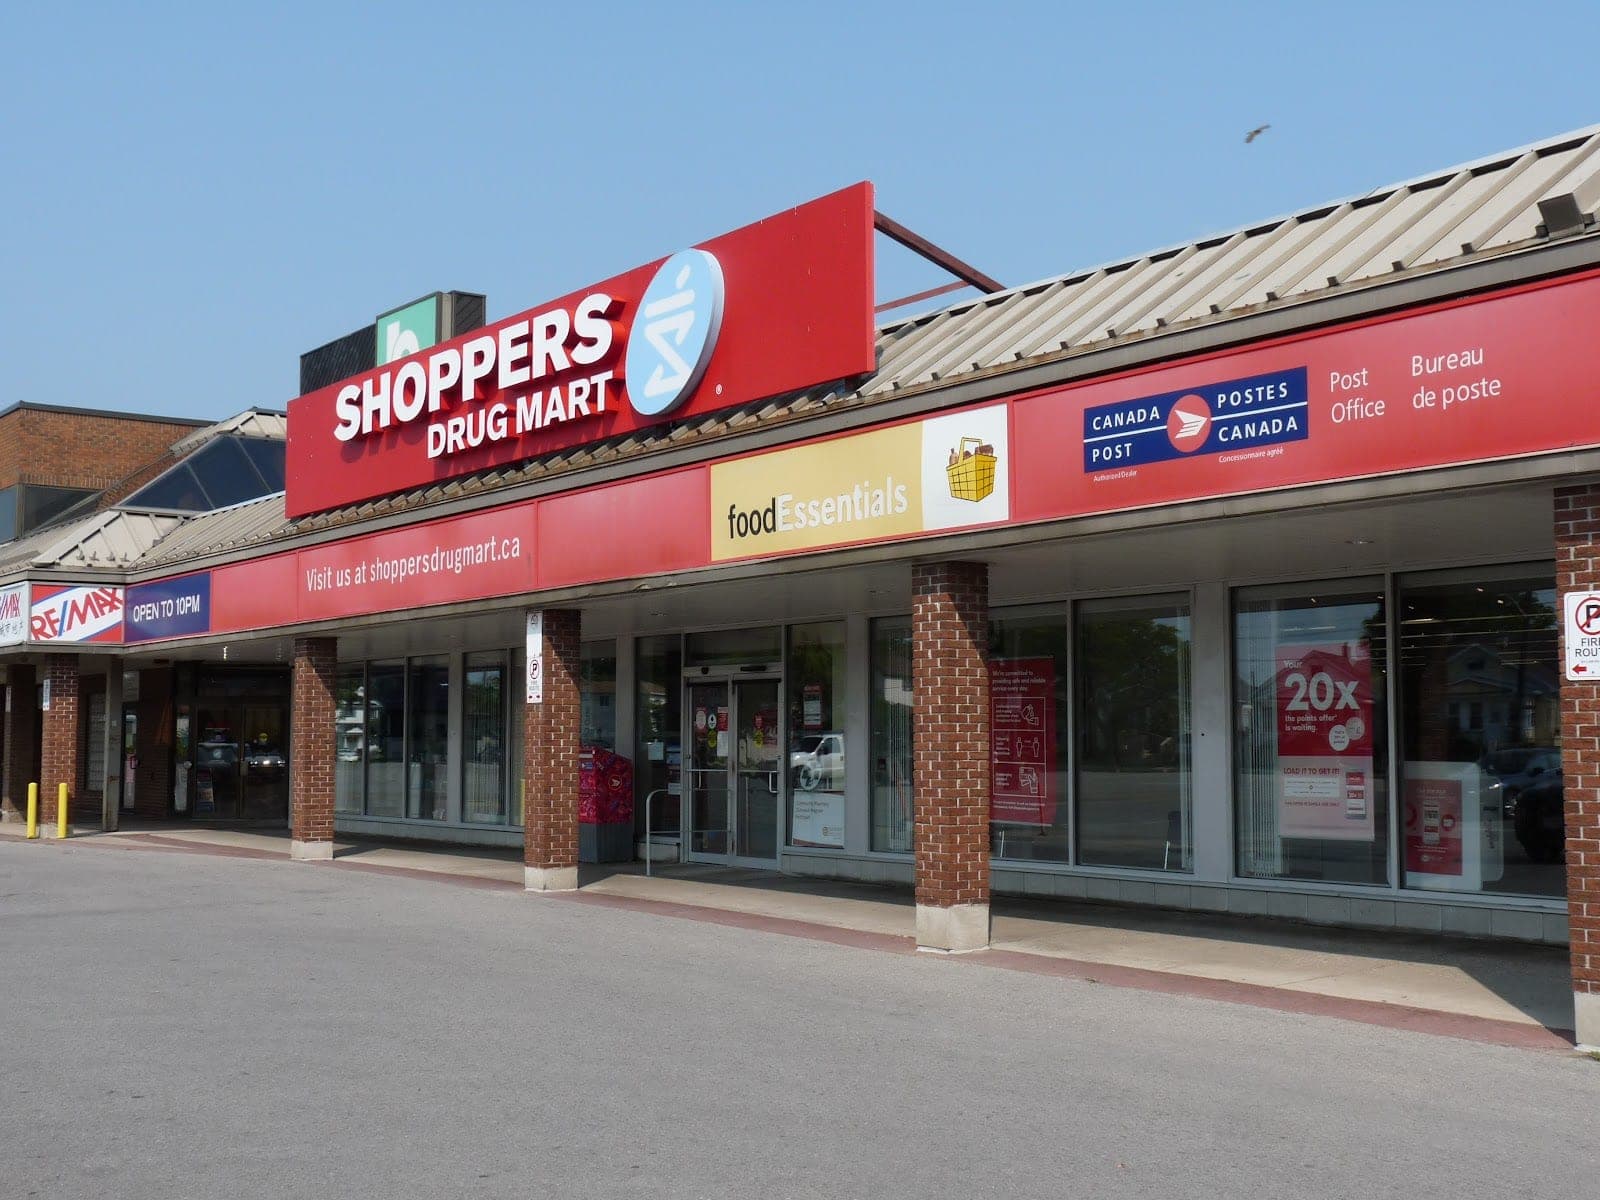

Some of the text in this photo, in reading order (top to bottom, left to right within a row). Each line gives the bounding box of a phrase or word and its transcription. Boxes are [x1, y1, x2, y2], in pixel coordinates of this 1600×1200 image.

[333, 293, 613, 442] SHOPPERS
[1411, 347, 1484, 377] Bureau
[1329, 367, 1369, 392] Post
[1412, 375, 1501, 410] de poste
[1217, 382, 1289, 408] POSTES
[427, 369, 615, 459] DRUG MART
[1092, 406, 1161, 431] CANADA
[1331, 398, 1385, 424] Office
[1218, 416, 1298, 442] CANADA
[1092, 443, 1133, 462] POST
[1218, 450, 1265, 463] Concessionnaire
[728, 476, 908, 539] foodEssentials
[306, 535, 520, 592] Visit us at shoppersdrugmart.ca
[133, 594, 200, 623] OPEN TO 10PM
[1575, 648, 1600, 657] ROU
[1581, 637, 1600, 647] FIR
[1283, 660, 1302, 669] Your
[1285, 671, 1361, 711] 20x
[1285, 714, 1296, 722] the
[1297, 714, 1317, 724] points
[1285, 723, 1290, 731] is
